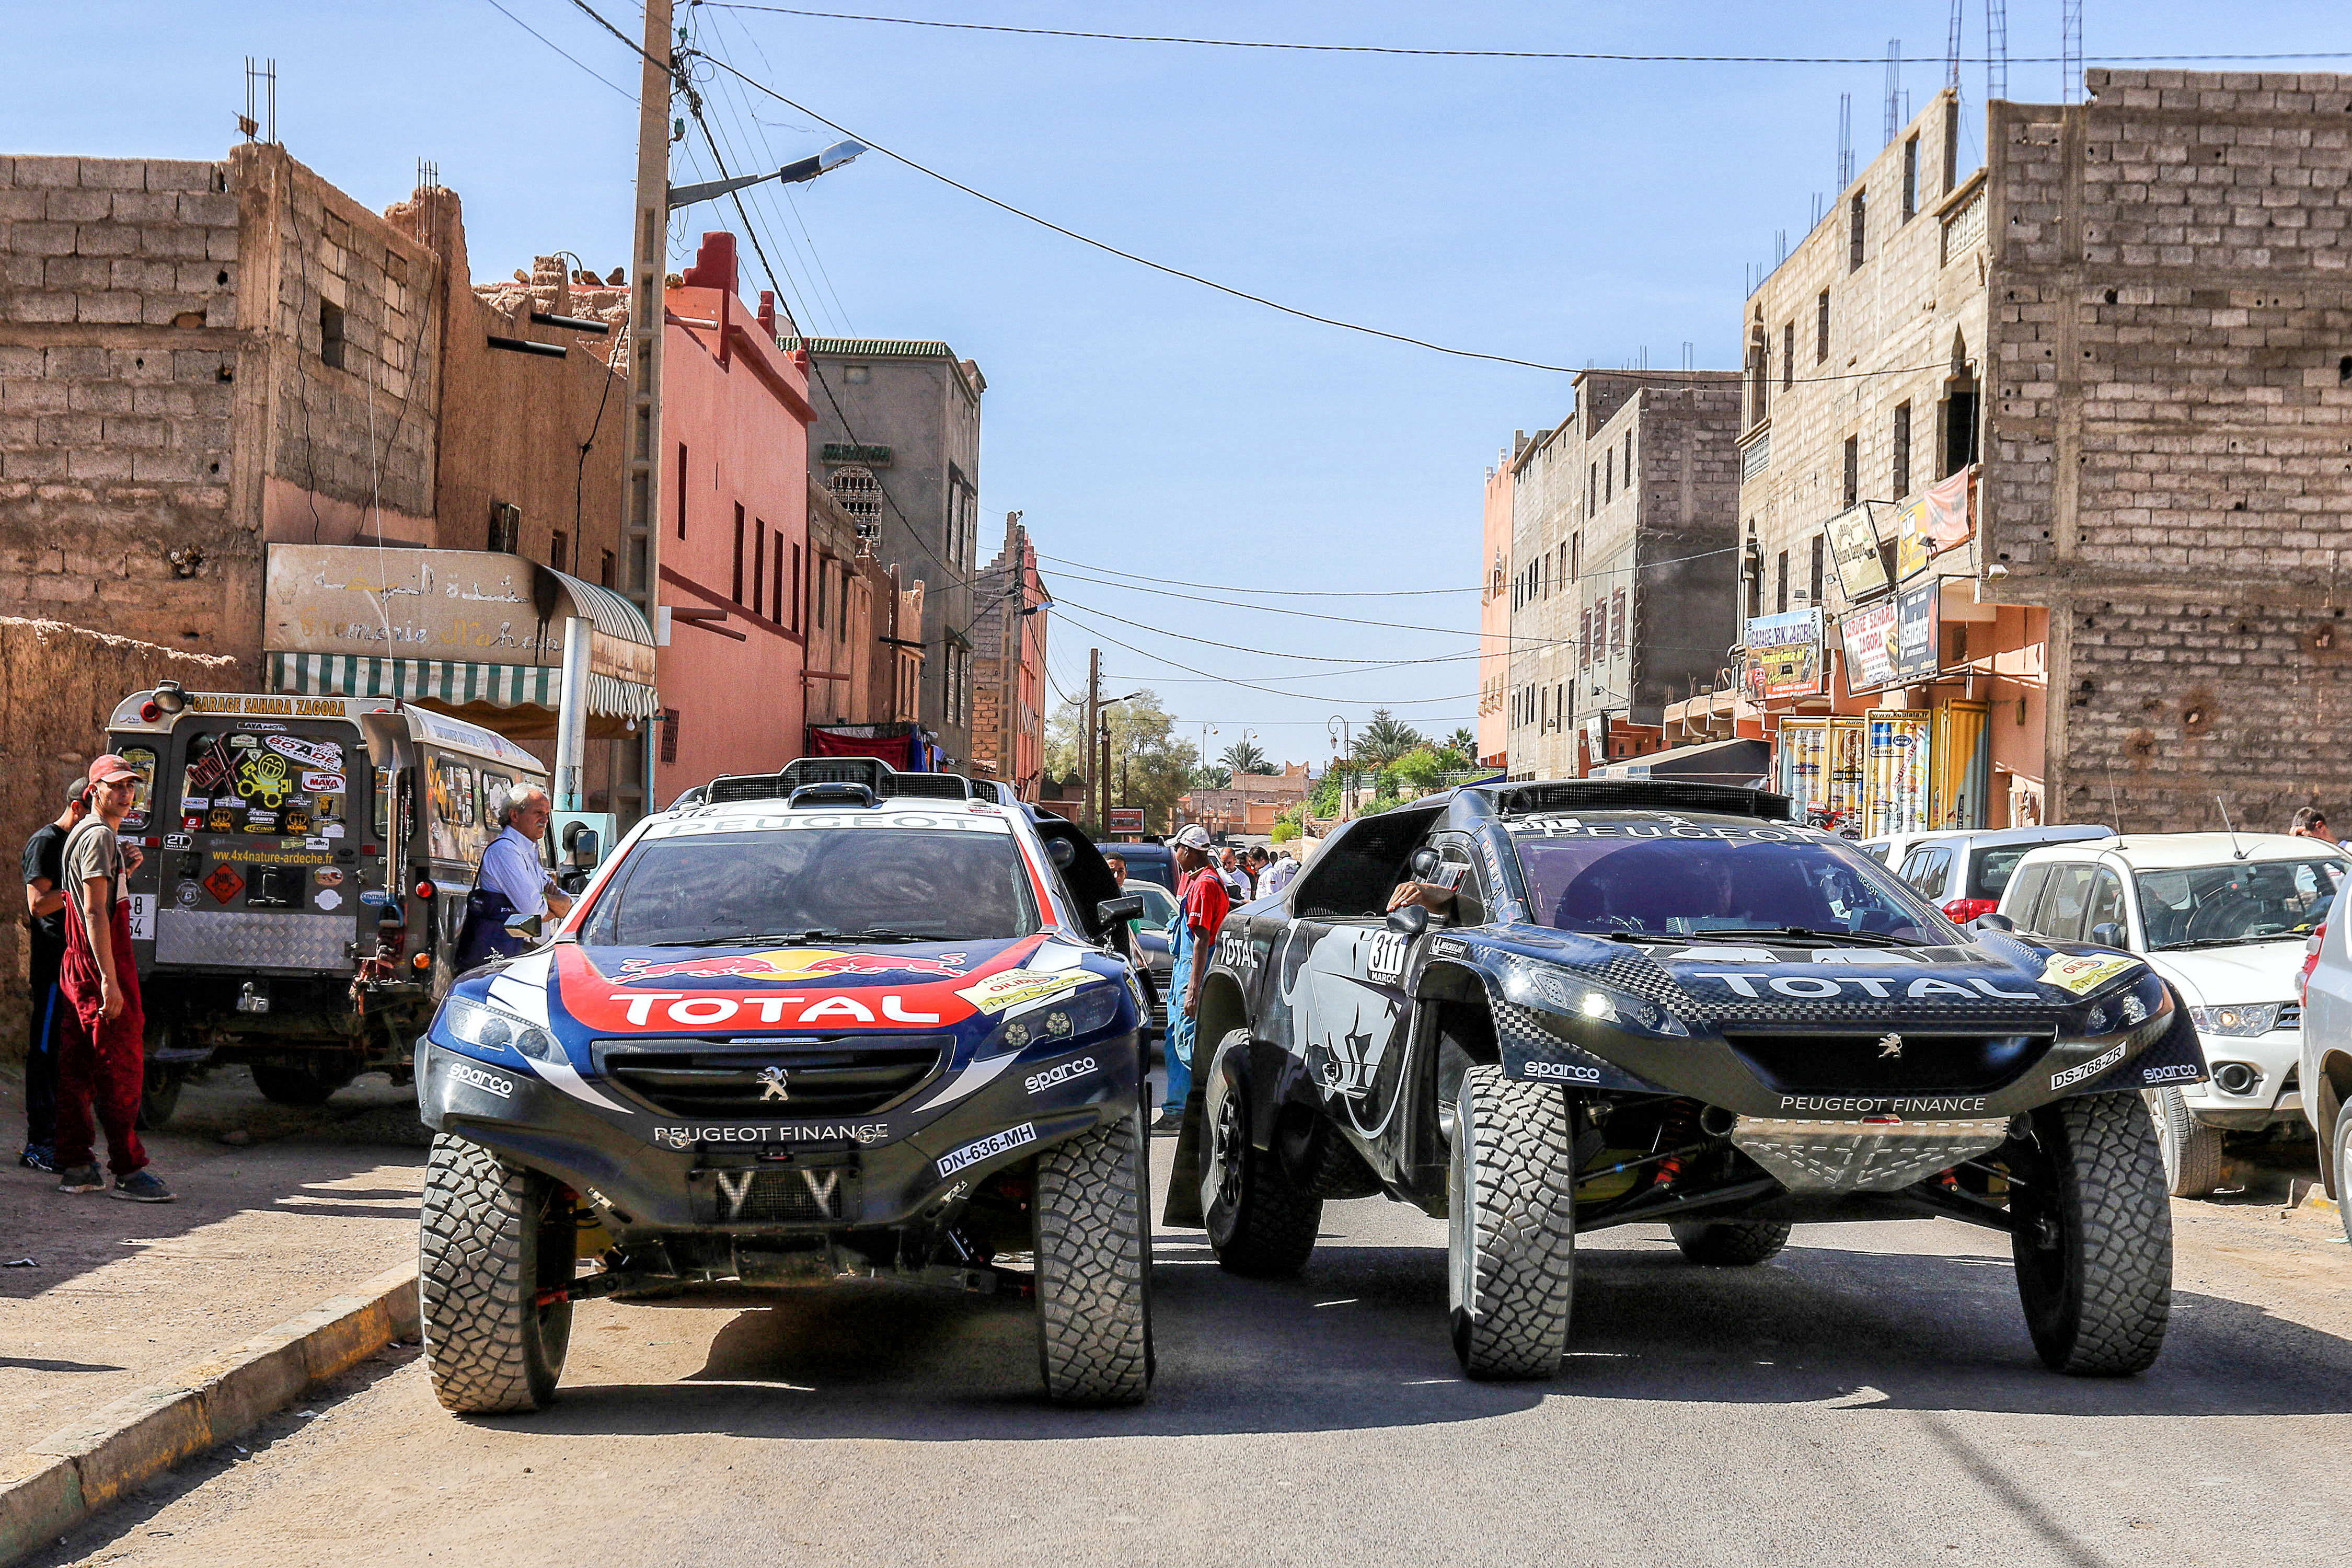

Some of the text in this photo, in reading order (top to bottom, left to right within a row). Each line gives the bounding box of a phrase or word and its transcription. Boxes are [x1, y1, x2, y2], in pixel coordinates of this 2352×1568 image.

[1870, 605, 1895, 629] SAHARA
[1860, 631, 1883, 653] ZAGORA
[192, 696, 345, 717] GARAGE SAHARA ZAGORA
[268, 742, 290, 752] Cross
[293, 752, 320, 763] enduro
[269, 737, 337, 764] BOADE
[668, 817, 977, 835] PEUGEOT
[1519, 821, 1563, 830] 311
[1546, 824, 1814, 844] PEUGEOT
[168, 834, 188, 844] 2T
[134, 896, 142, 915] 8
[1220, 930, 1258, 969] TOTAL
[1374, 934, 1402, 971] 311
[1440, 941, 1466, 954] MICHELIN
[990, 977, 1047, 991] OiLibya
[1371, 971, 1397, 985] MAROC
[1693, 973, 2040, 999] TOTAL
[609, 994, 940, 1025] TOTAL
[1025, 1057, 1096, 1091] sparco
[1525, 1061, 1600, 1080] sparco
[2054, 1046, 2122, 1087] DS-768-ZR
[2143, 1064, 2197, 1083] sparco
[447, 1062, 514, 1096] sparco
[1780, 1097, 1986, 1112] PEUGEOT FINANCE
[940, 1125, 1033, 1174] DN-636-MH
